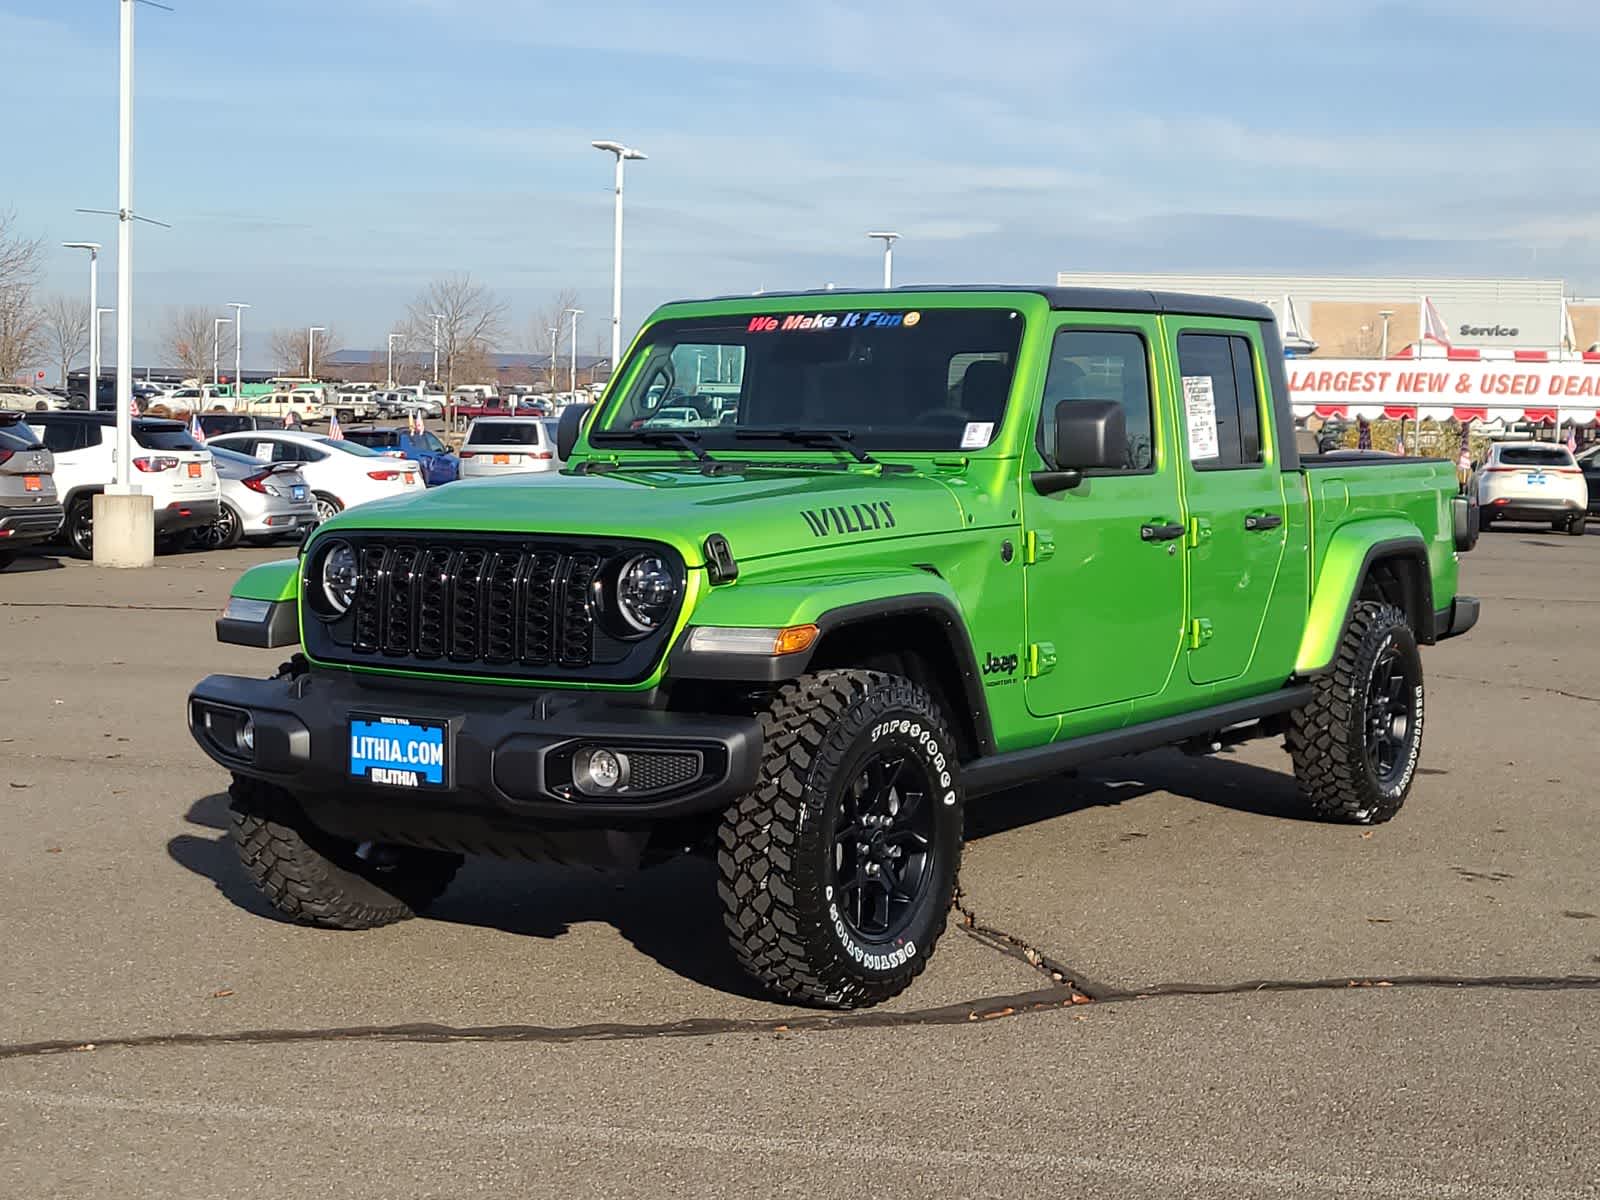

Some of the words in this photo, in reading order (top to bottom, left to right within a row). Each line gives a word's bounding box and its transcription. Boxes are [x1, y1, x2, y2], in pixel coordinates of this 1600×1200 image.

[747, 316, 779, 333] We
[781, 314, 838, 330] Make
[840, 312, 861, 328] It
[862, 311, 903, 327] Fun
[1459, 324, 1520, 337] Service
[1288, 371, 1391, 392] LARGEST
[1396, 372, 1450, 393] NEW
[1455, 373, 1473, 394] &
[1480, 373, 1541, 395] USED
[799, 500, 896, 537] WILLYS
[982, 652, 1018, 675] Jeep
[352, 735, 443, 766] LITHIA.COM
[383, 769, 418, 787] LITHIA
[829, 903, 917, 971] DESTINATION
